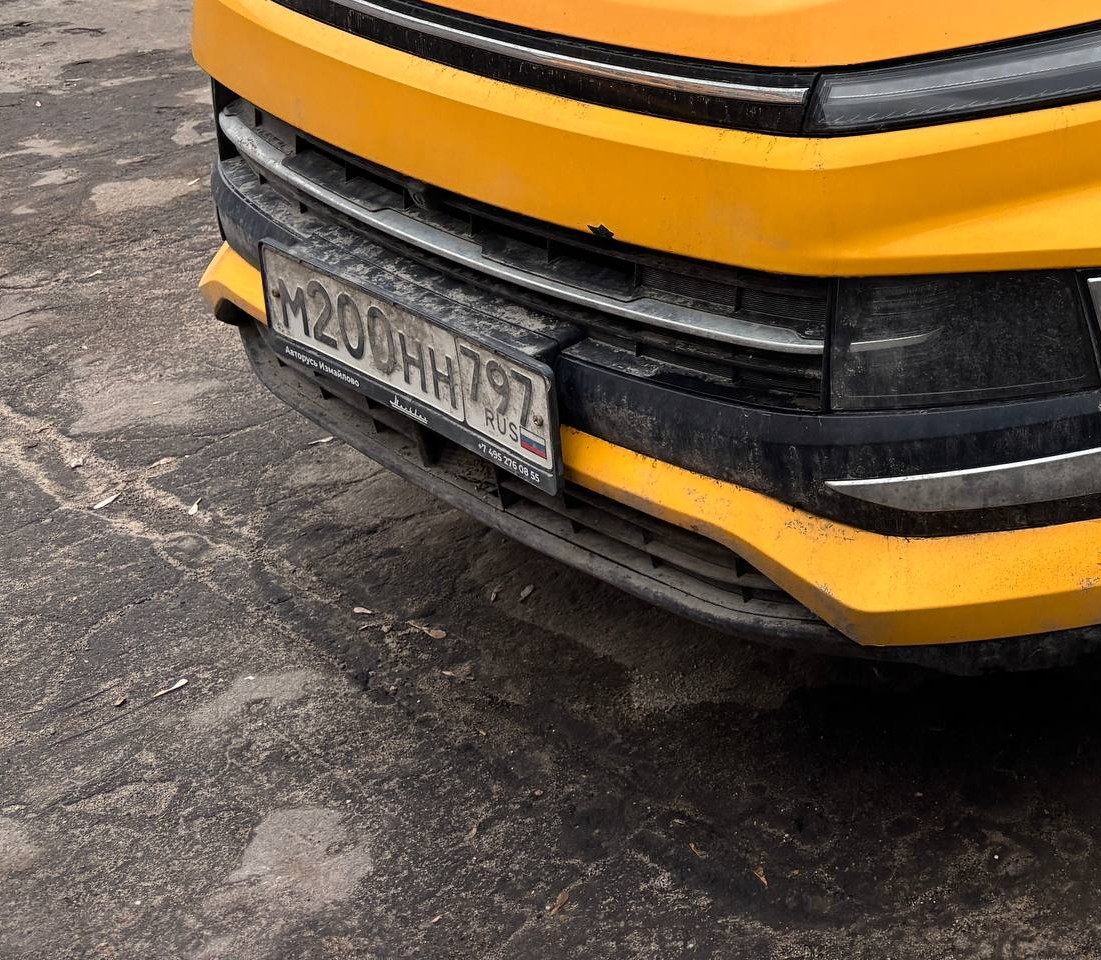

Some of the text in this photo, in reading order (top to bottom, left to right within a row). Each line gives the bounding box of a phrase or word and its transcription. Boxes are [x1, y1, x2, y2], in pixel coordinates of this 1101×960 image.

[277, 278, 532, 427] М200НН 797
[285, 345, 318, 368] Авторусь
[484, 407, 519, 443] RUS
[478, 443, 540, 483] +7 495 276 08 55
